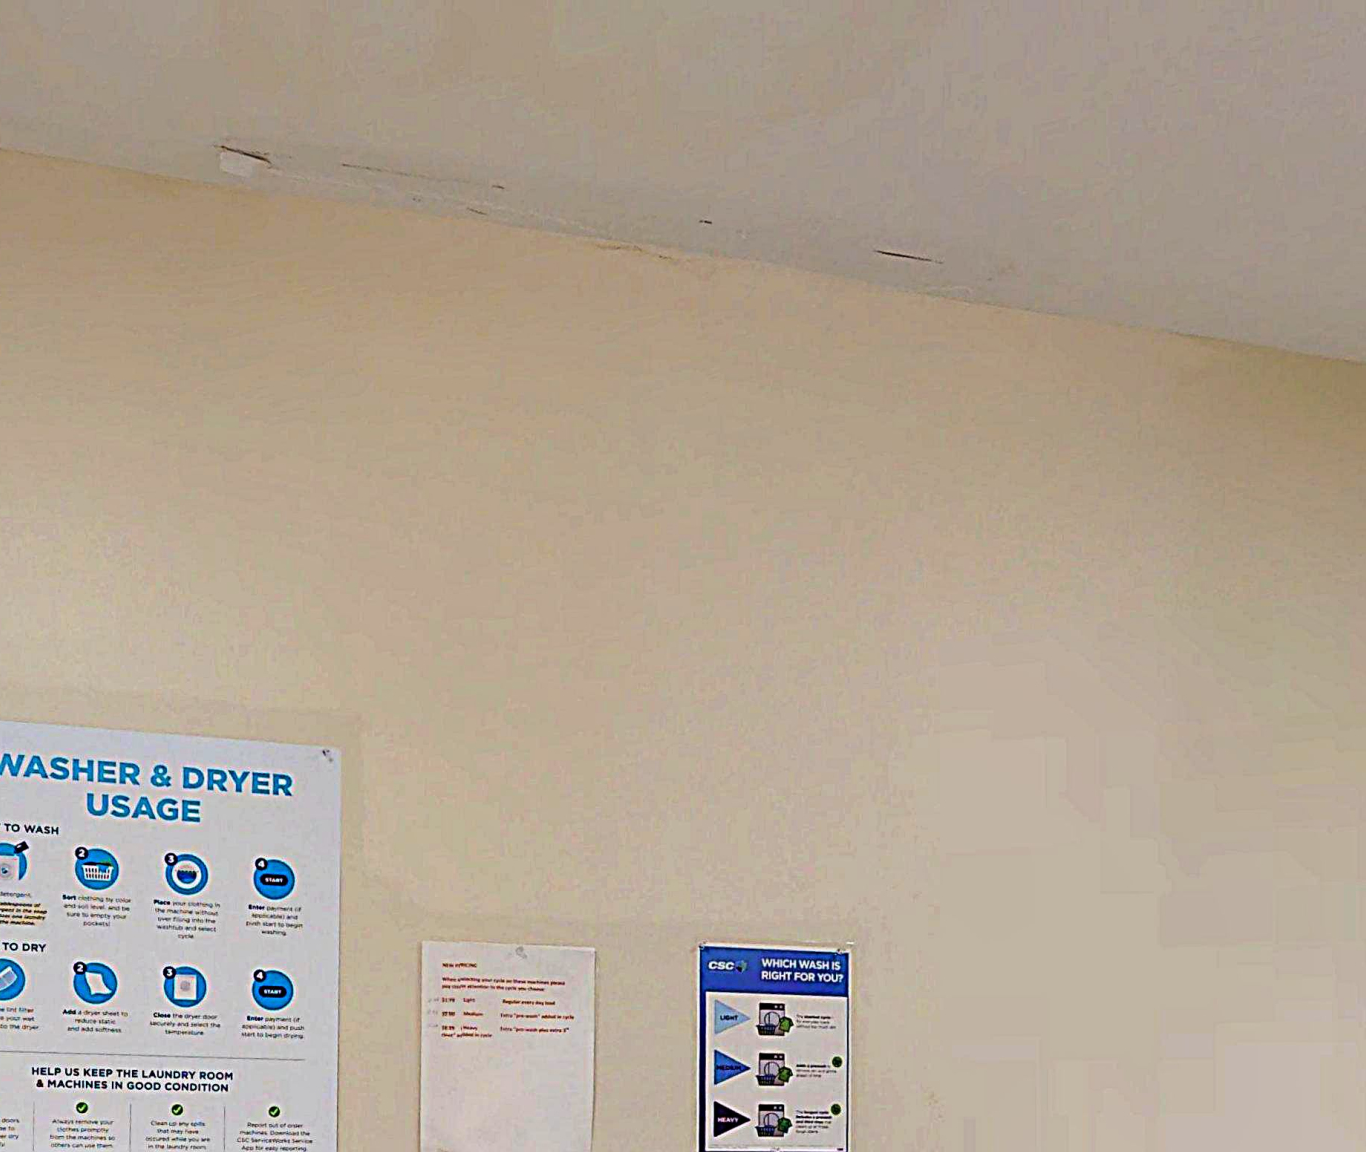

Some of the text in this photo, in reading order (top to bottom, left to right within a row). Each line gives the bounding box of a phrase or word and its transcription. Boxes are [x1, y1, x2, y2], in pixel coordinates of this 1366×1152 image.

[151, 765, 172, 788] &
[182, 767, 293, 796] DRYER
[86, 792, 202, 822] USAGE
[4, 823, 20, 833] TO
[24, 824, 60, 835] WASH
[78, 848, 85, 859] 2
[167, 855, 174, 865] 3
[257, 859, 265, 869] 4
[3, 942, 18, 951] TO
[22, 943, 46, 952] DRY
[708, 961, 734, 970] CSC
[762, 959, 841, 970] WHICH WASH IS
[762, 972, 844, 983] RIGHT FOR YOU?
[32, 1067, 233, 1081] HELP US KEEP THE LAUNDRY ROOM
[48, 1080, 107, 1089] MACHINES
[112, 1081, 122, 1089] IN
[127, 1082, 161, 1091] GOOD
[165, 1082, 229, 1092] CONDITION
